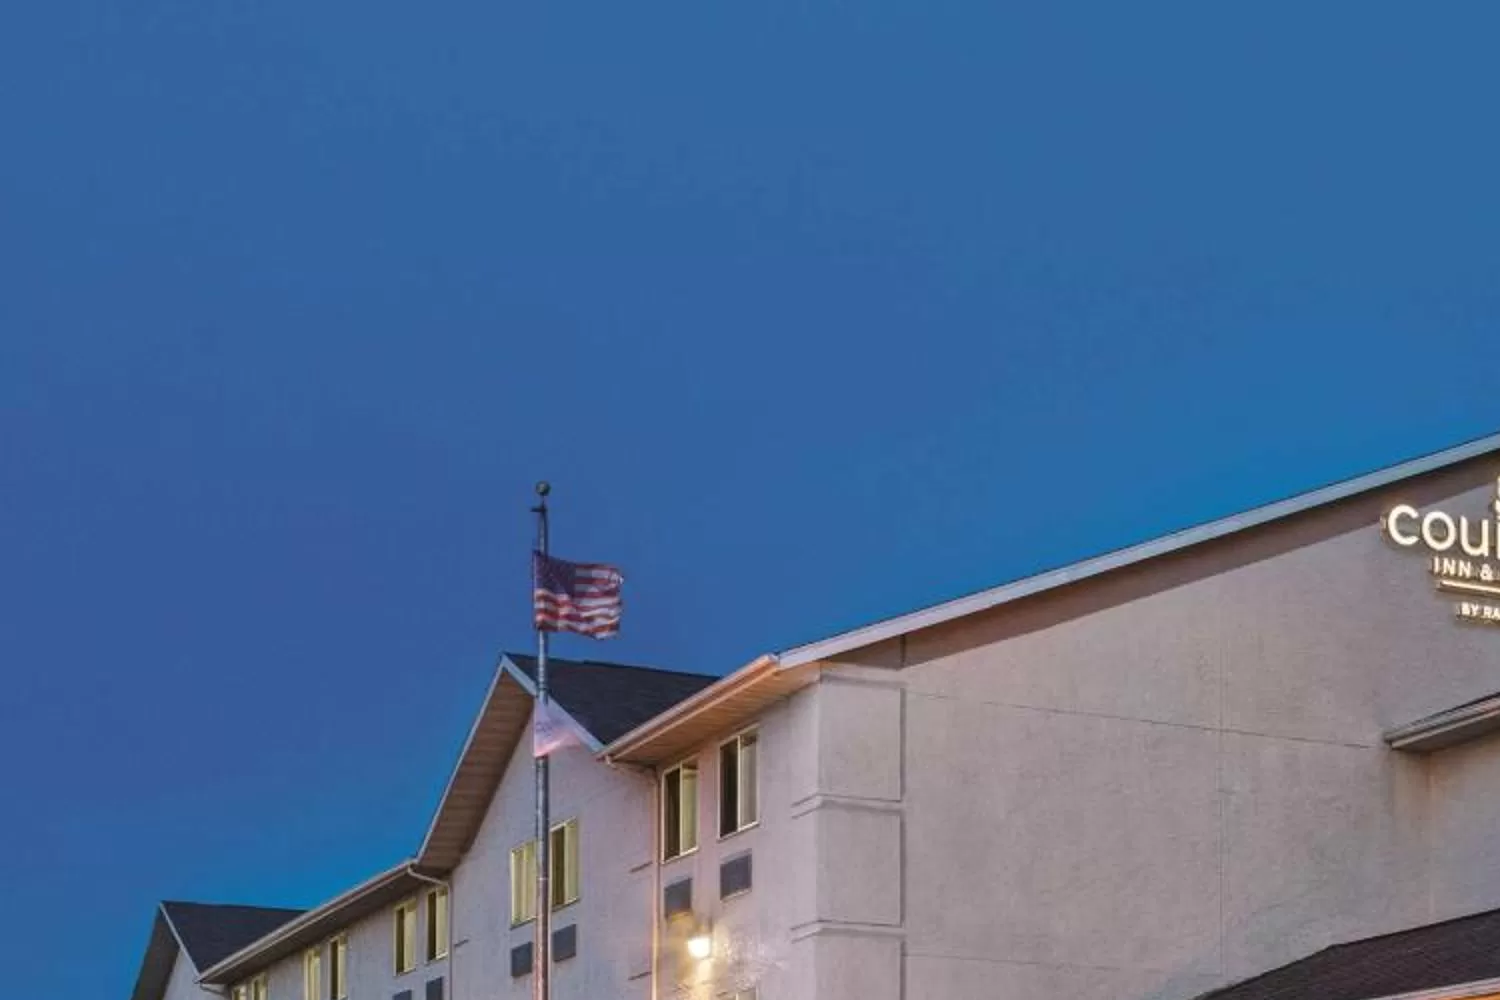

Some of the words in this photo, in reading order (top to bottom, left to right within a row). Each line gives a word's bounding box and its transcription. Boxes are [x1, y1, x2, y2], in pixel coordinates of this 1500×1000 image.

[1433, 556, 1472, 578] INN
[1480, 563, 1494, 581] &
[1461, 602, 1479, 617] BY
